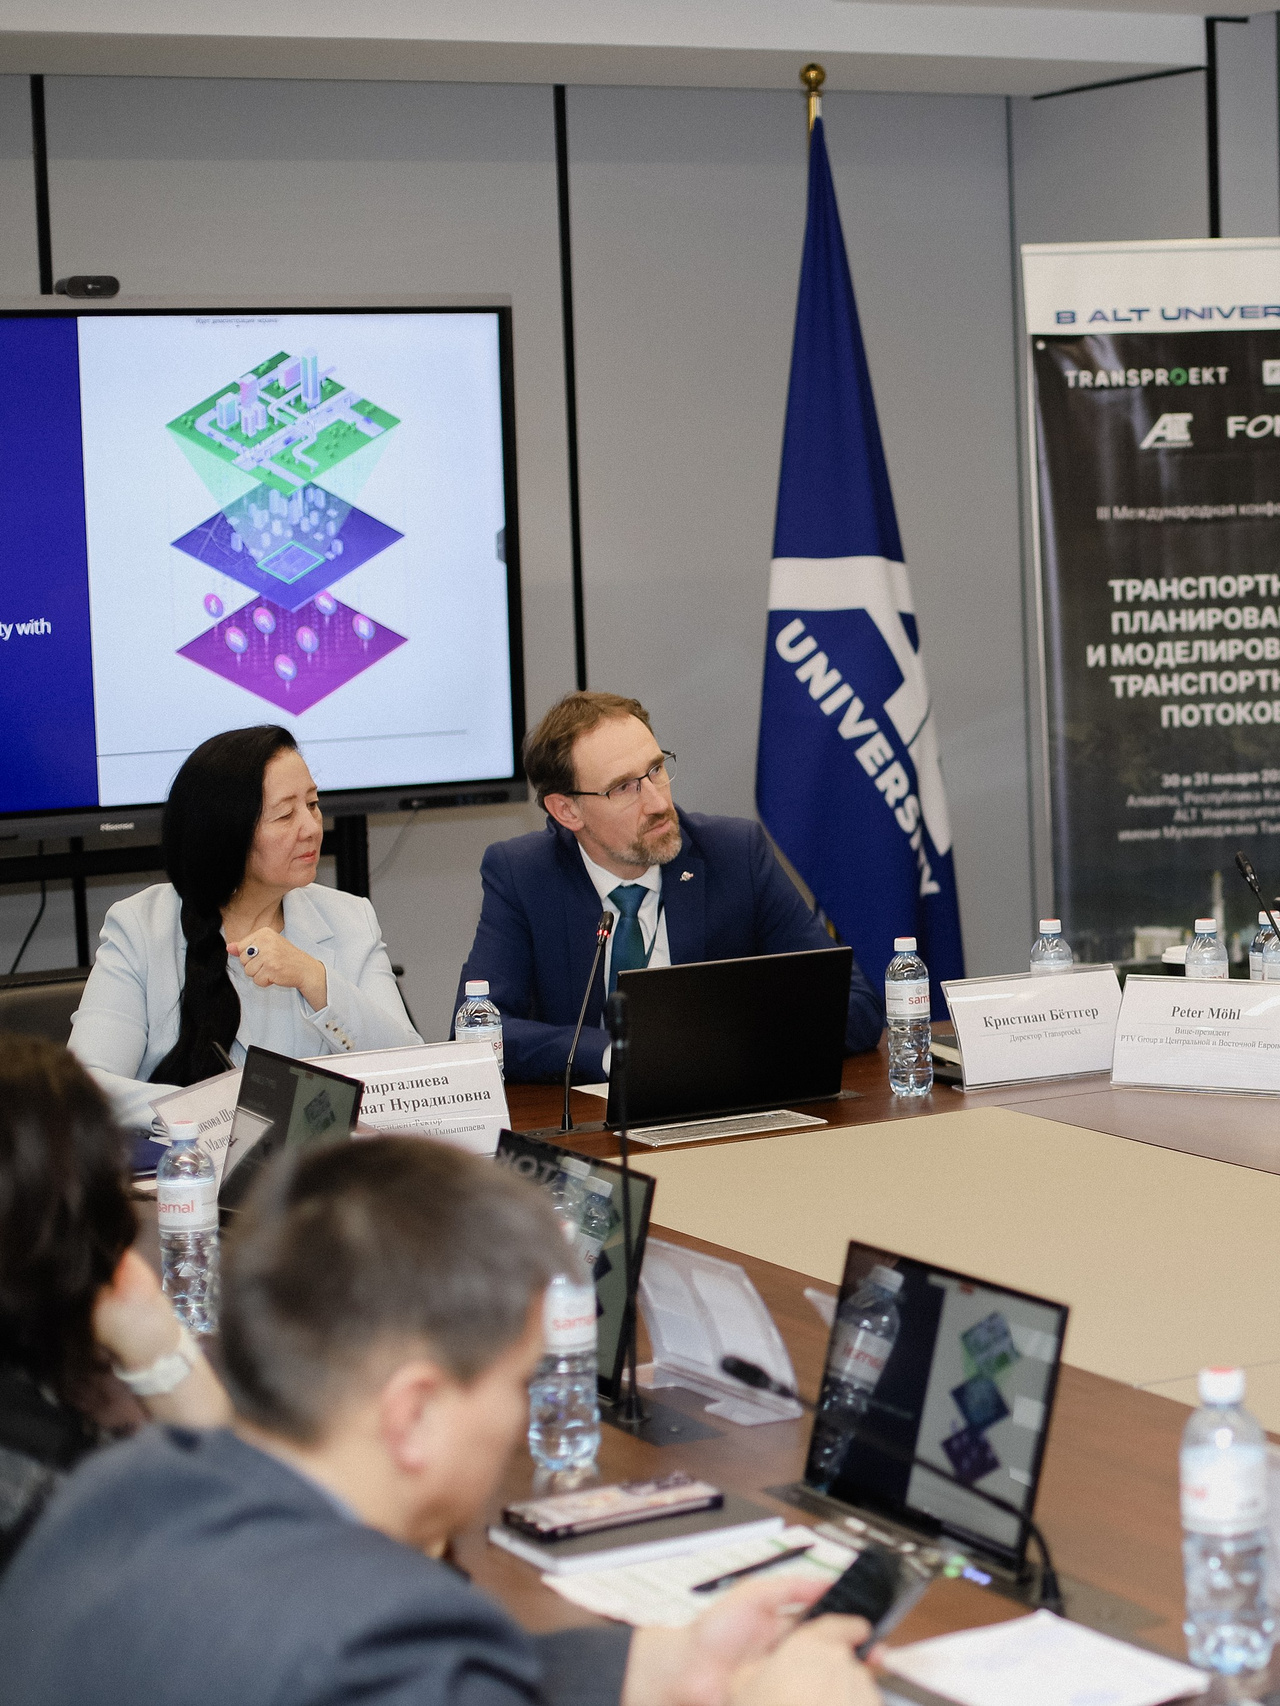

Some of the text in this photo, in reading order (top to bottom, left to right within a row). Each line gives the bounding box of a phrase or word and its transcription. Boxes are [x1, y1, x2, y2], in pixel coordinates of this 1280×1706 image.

[1089, 309, 1150, 323] ALT
[1064, 366, 1229, 388] TRANSPROEKT
[15, 618, 51, 636] with
[1086, 644, 1106, 668] И
[775, 618, 941, 896] UNIVERSY
[983, 1007, 1099, 1030] Кристиан Бёттгер
[1171, 1006, 1241, 1021] Peter Möhl
[1010, 1032, 1042, 1043] Директор
[1137, 1036, 1158, 1045] Group
[1218, 1039, 1256, 1049] Восточной
[390, 1090, 491, 1113] Нурадиловна
